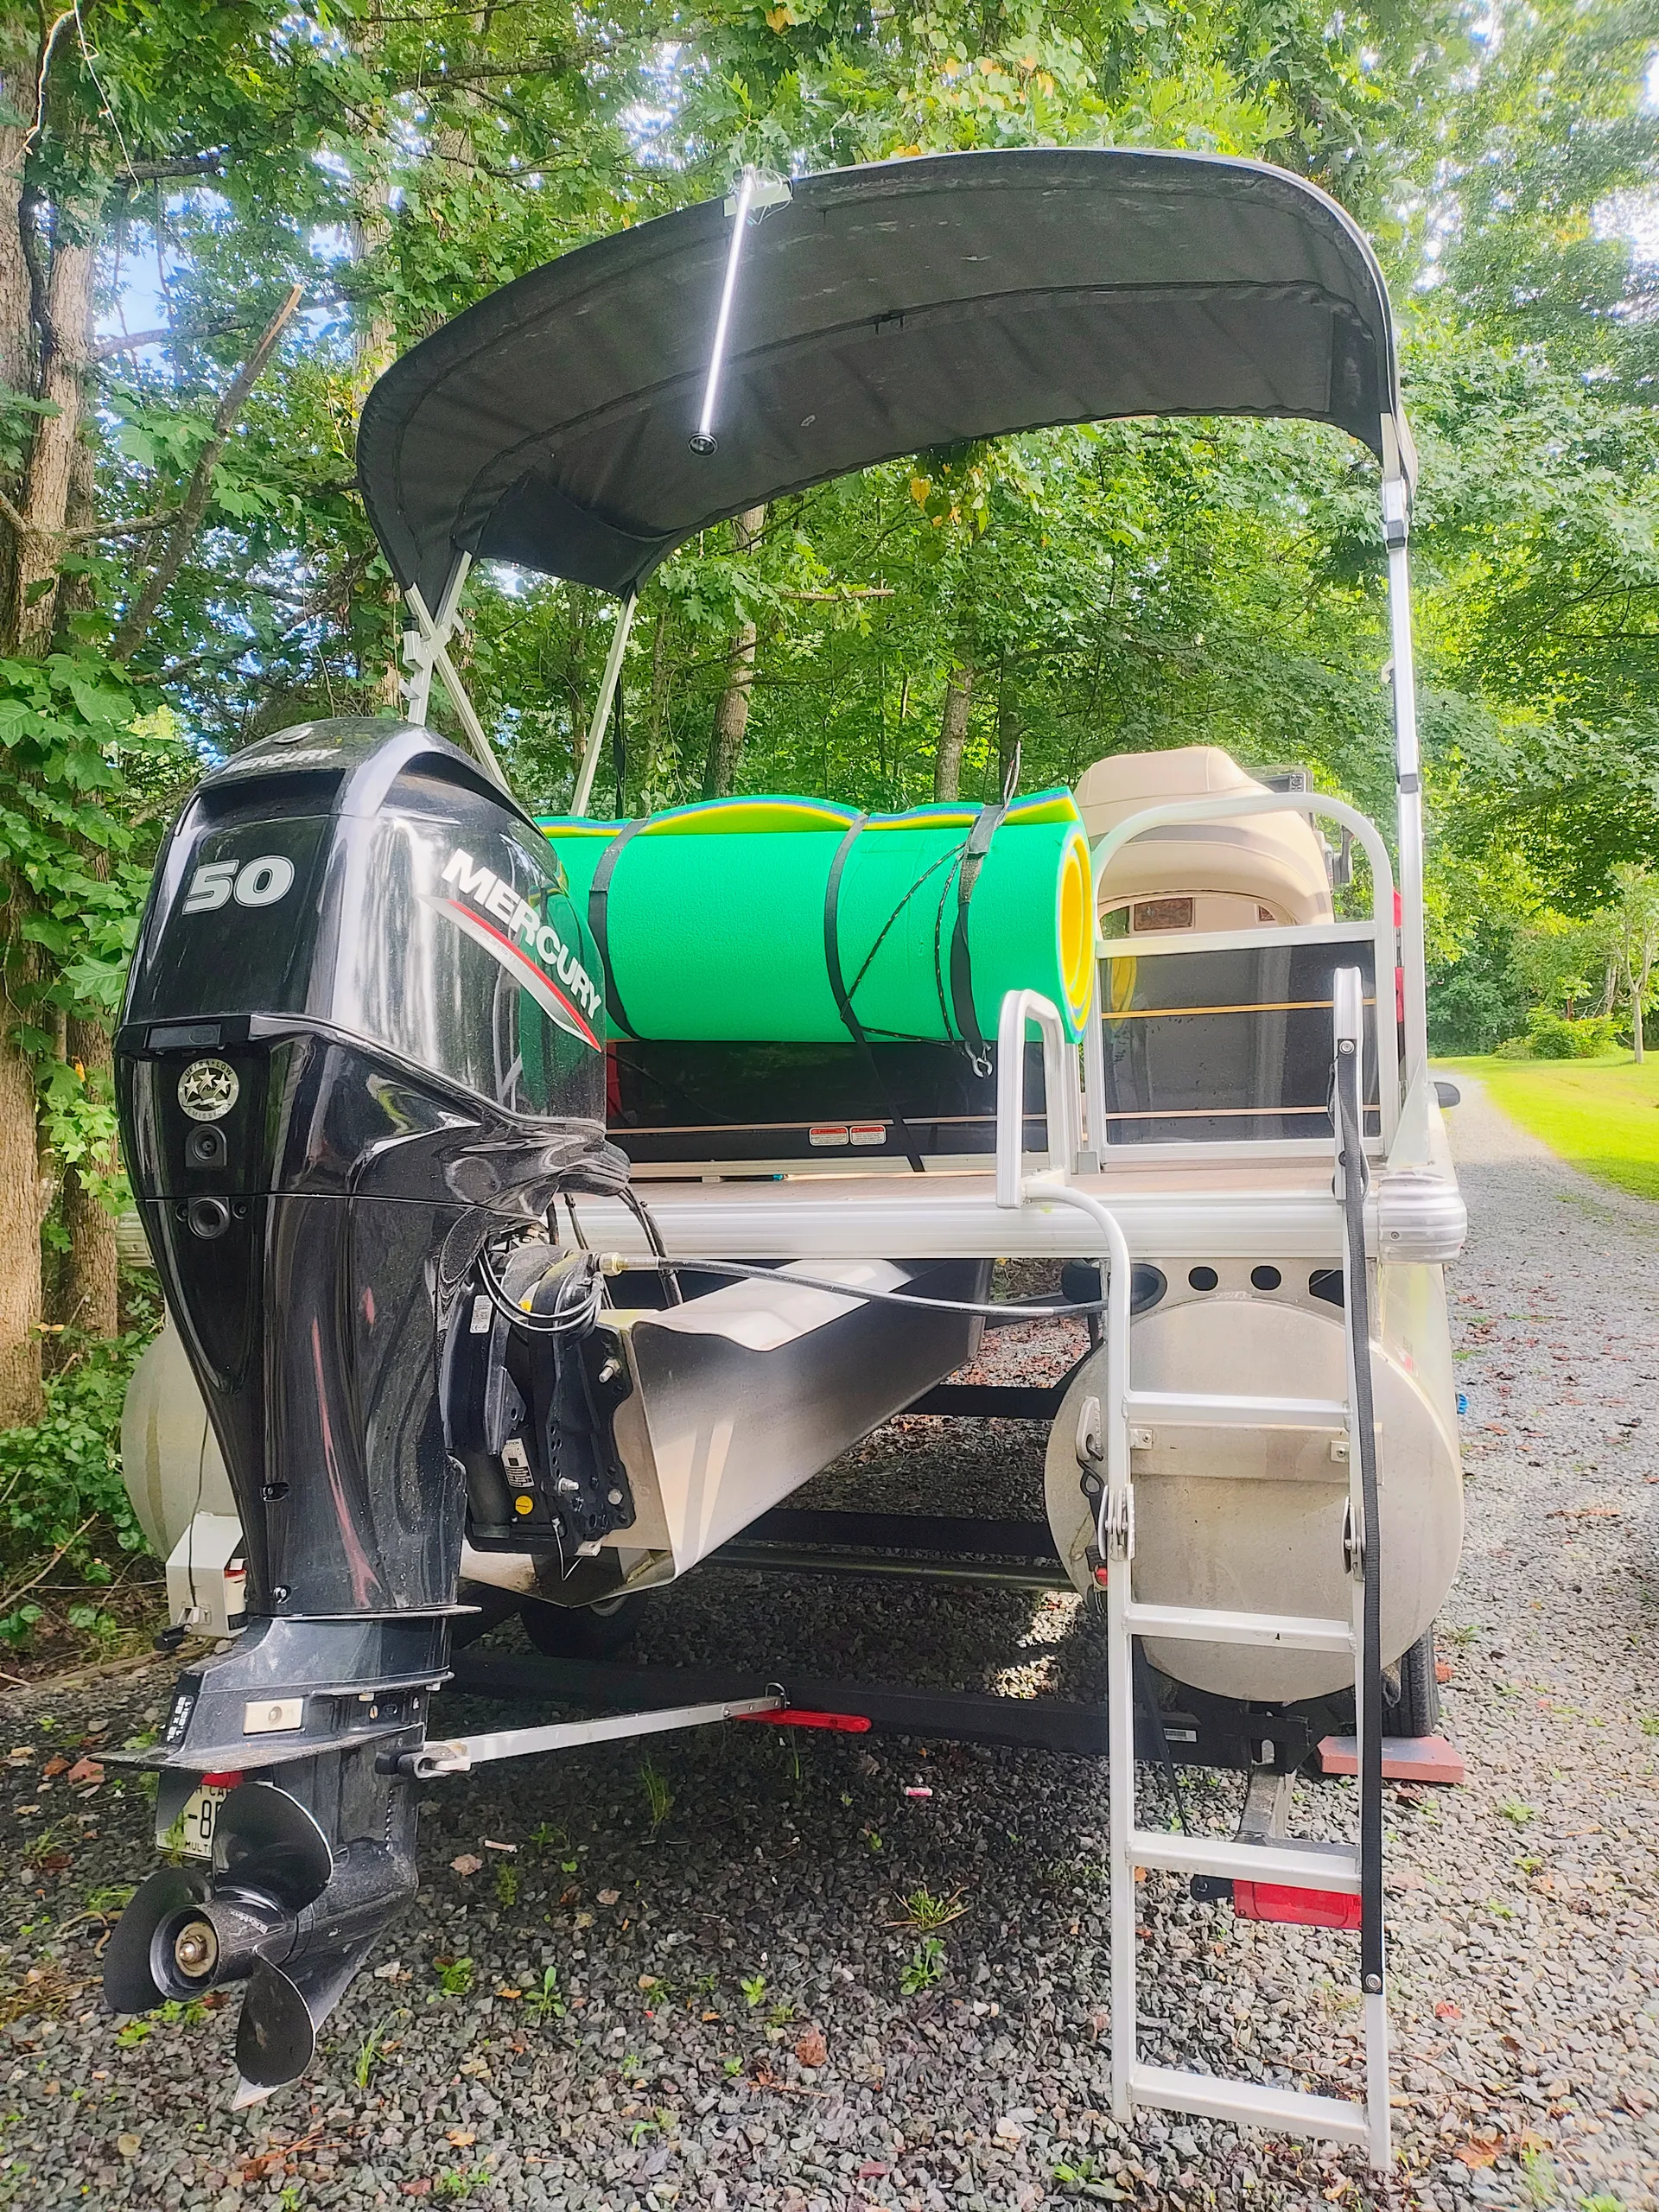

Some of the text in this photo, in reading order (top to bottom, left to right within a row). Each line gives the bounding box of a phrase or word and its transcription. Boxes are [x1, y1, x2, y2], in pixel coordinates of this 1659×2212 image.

[219, 748, 342, 776] MERCURY
[181, 855, 296, 916] 50
[441, 848, 602, 1020] MERCURY
